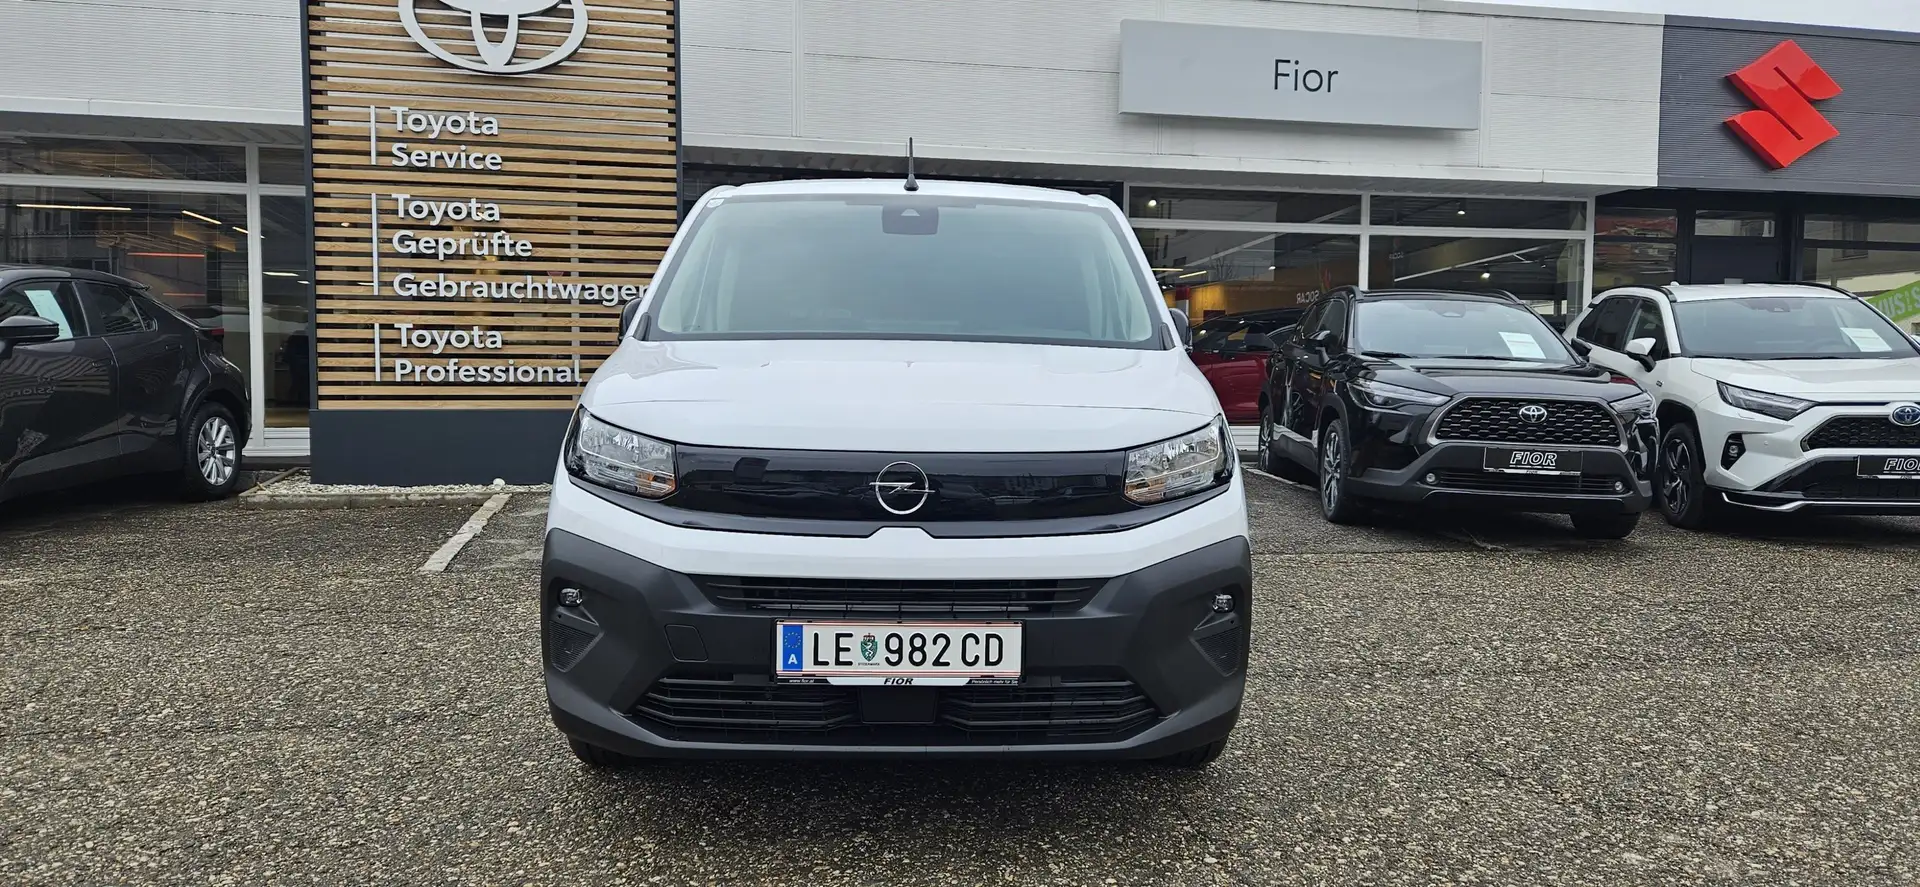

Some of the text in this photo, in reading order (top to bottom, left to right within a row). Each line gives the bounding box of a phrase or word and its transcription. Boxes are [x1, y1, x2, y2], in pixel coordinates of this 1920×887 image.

[1273, 59, 1338, 93] Fior
[391, 106, 499, 139] Toyota
[391, 143, 502, 170] Service
[391, 193, 500, 226] Toyota
[392, 229, 533, 260] Geprüfte
[393, 323, 502, 354] Toyota
[395, 359, 582, 383] Professional
[1510, 451, 1557, 466] FIOR
[1883, 458, 1920, 471] FIO
[788, 654, 798, 664] A
[813, 632, 1004, 667] LE 982 CD
[883, 677, 914, 685] FIOR
